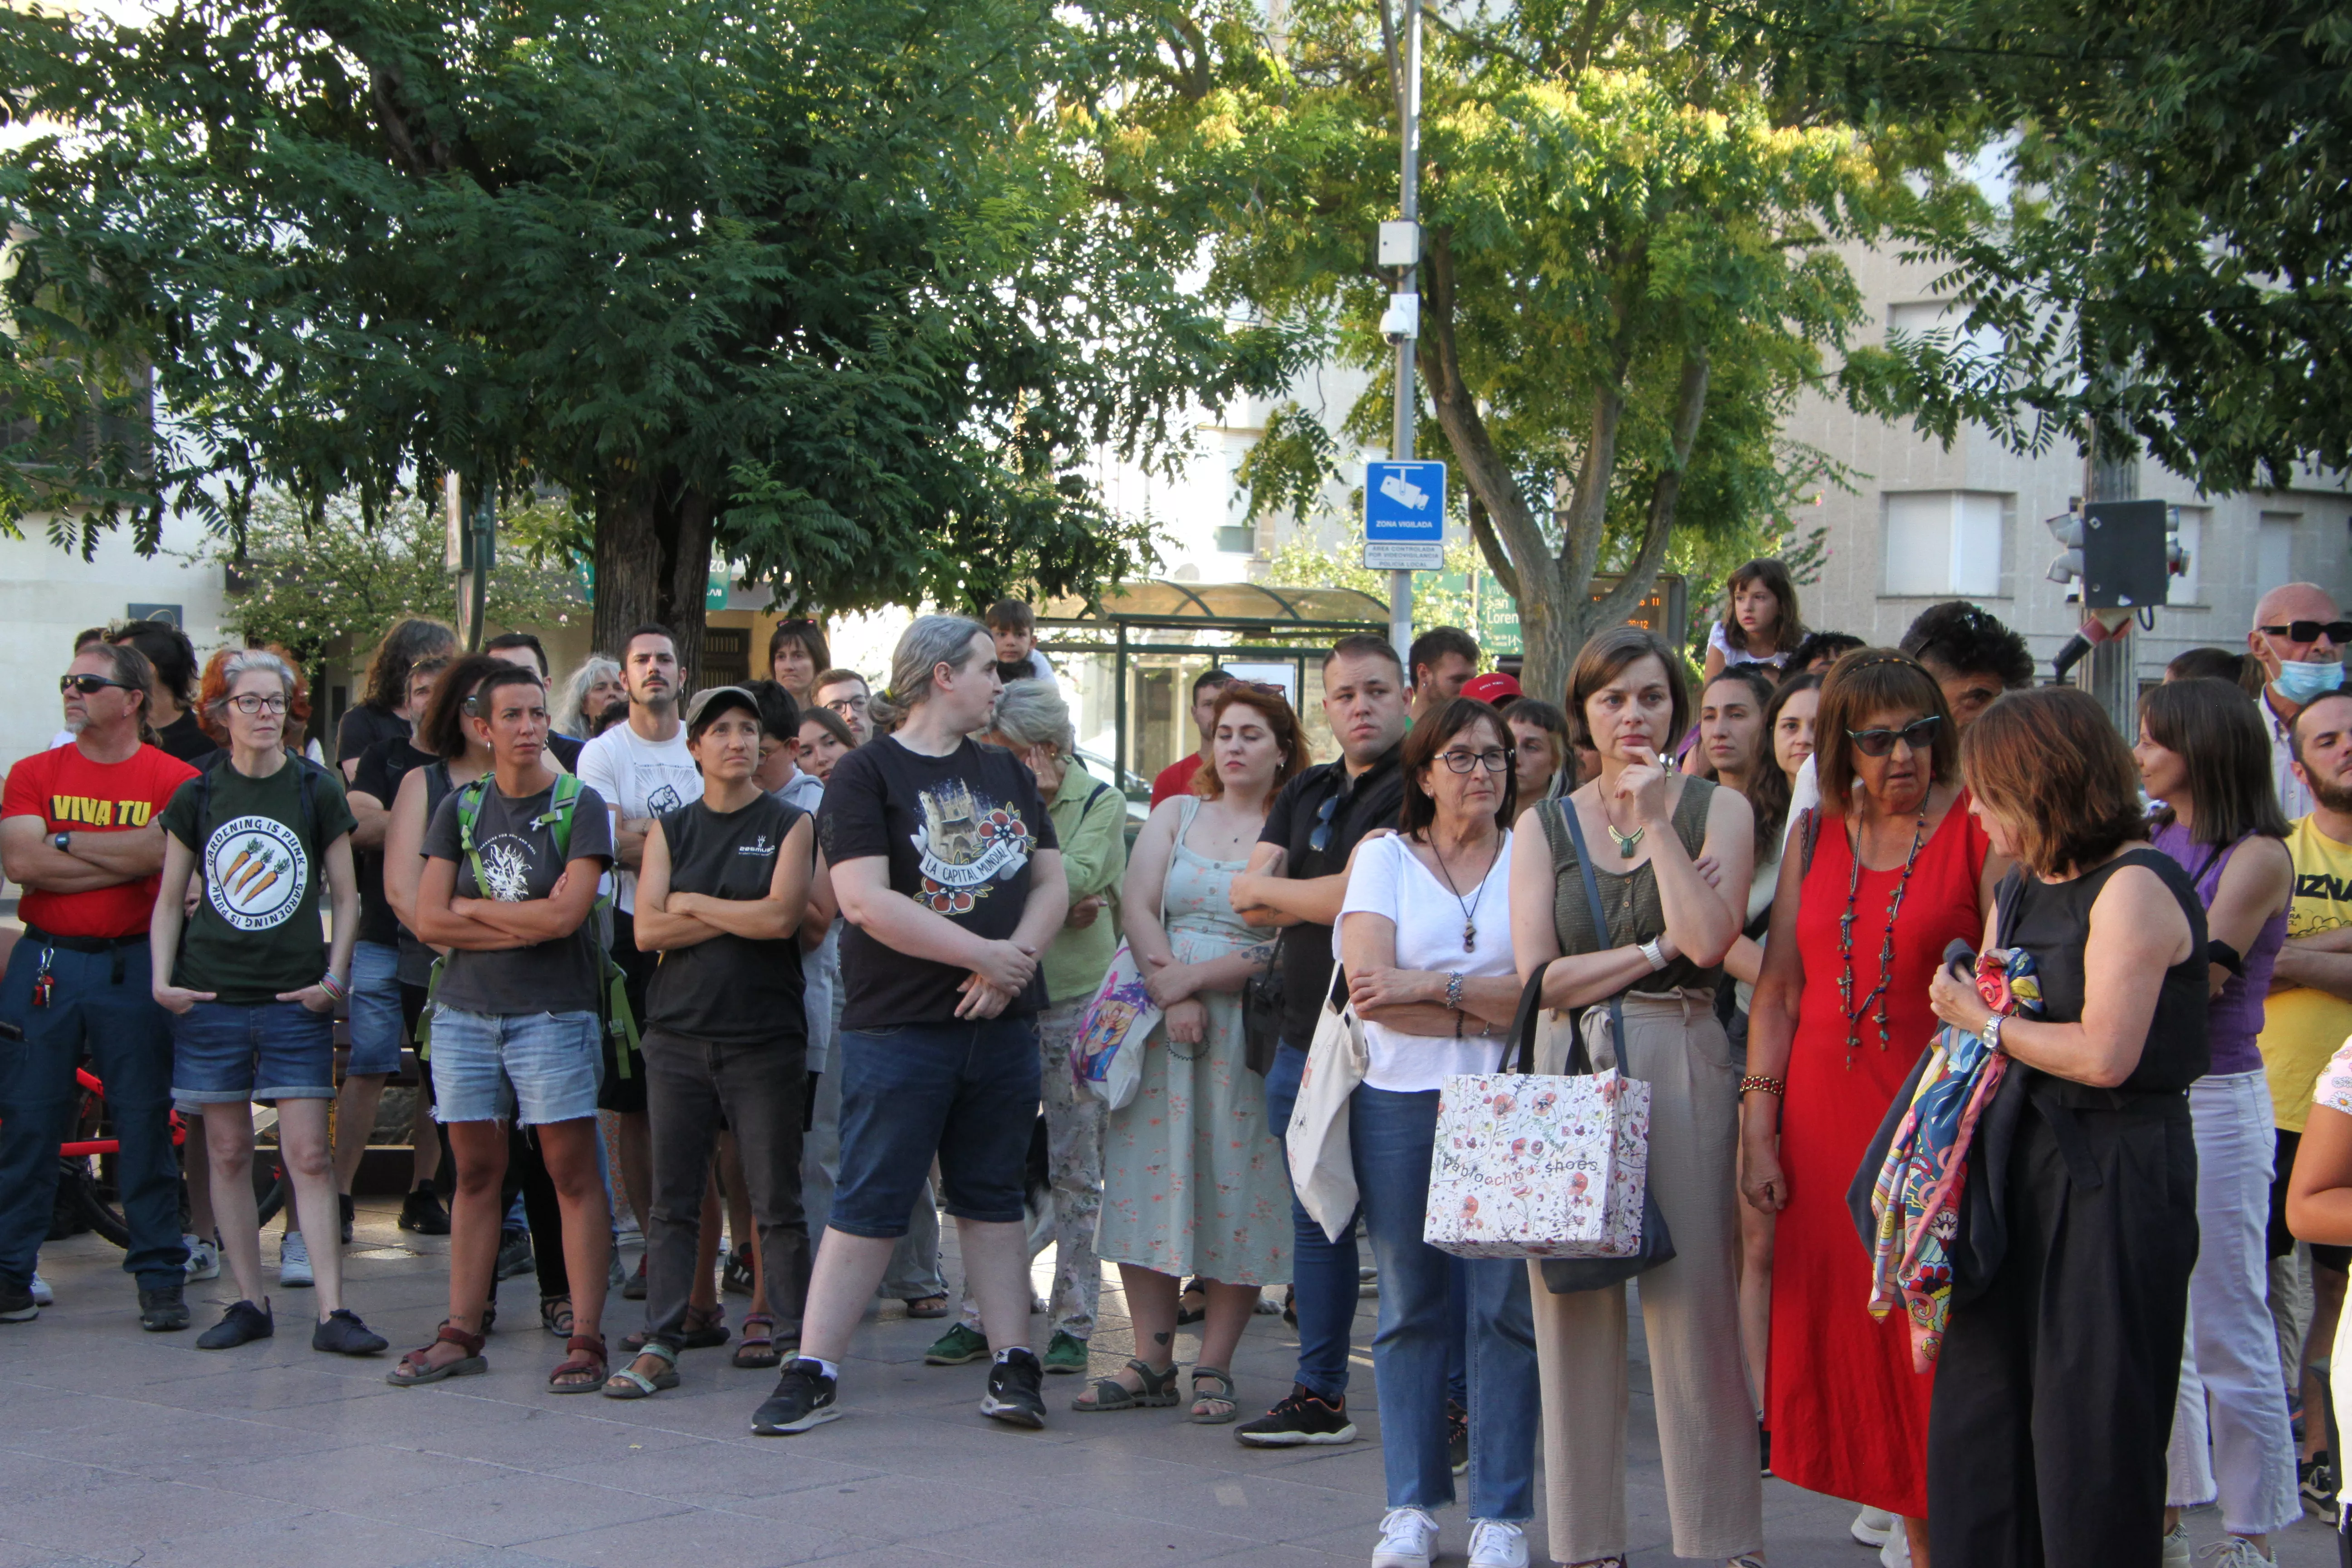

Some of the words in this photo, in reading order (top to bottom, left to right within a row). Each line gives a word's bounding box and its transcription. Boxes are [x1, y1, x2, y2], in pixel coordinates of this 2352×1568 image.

[1487, 595, 1509, 609] San
[1652, 597, 1660, 606] 11
[52, 794, 112, 826] VIVA
[117, 800, 151, 826] TU
[207, 818, 262, 866] GARDENING
[267, 822, 280, 833] IS
[281, 831, 305, 865] PUNK
[925, 858, 937, 875] LA
[943, 867, 979, 883] CAPITAL
[976, 845, 1008, 876] MUNDIAL
[212, 885, 229, 916] PUNK
[245, 883, 303, 927] GARDENING
[230, 914, 241, 925] IS
[1545, 1159, 1597, 1174] shoes
